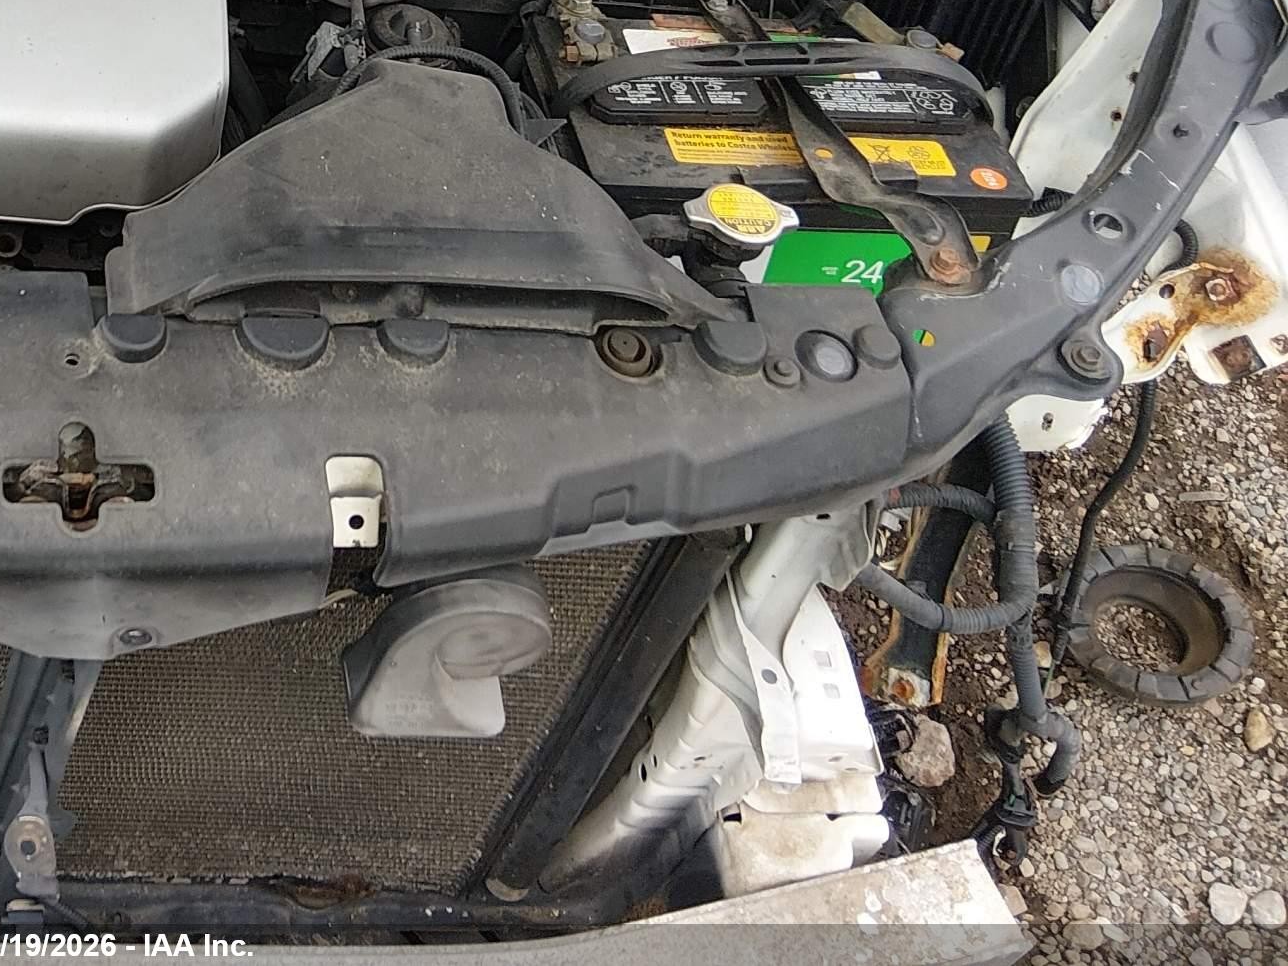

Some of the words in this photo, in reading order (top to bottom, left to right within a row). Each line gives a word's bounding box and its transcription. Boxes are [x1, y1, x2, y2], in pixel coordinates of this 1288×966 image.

[671, 131, 703, 139] Return
[703, 134, 745, 142] warranty
[674, 139, 714, 147] batteries
[723, 217, 772, 227] CAUTION
[841, 259, 884, 284] 24
